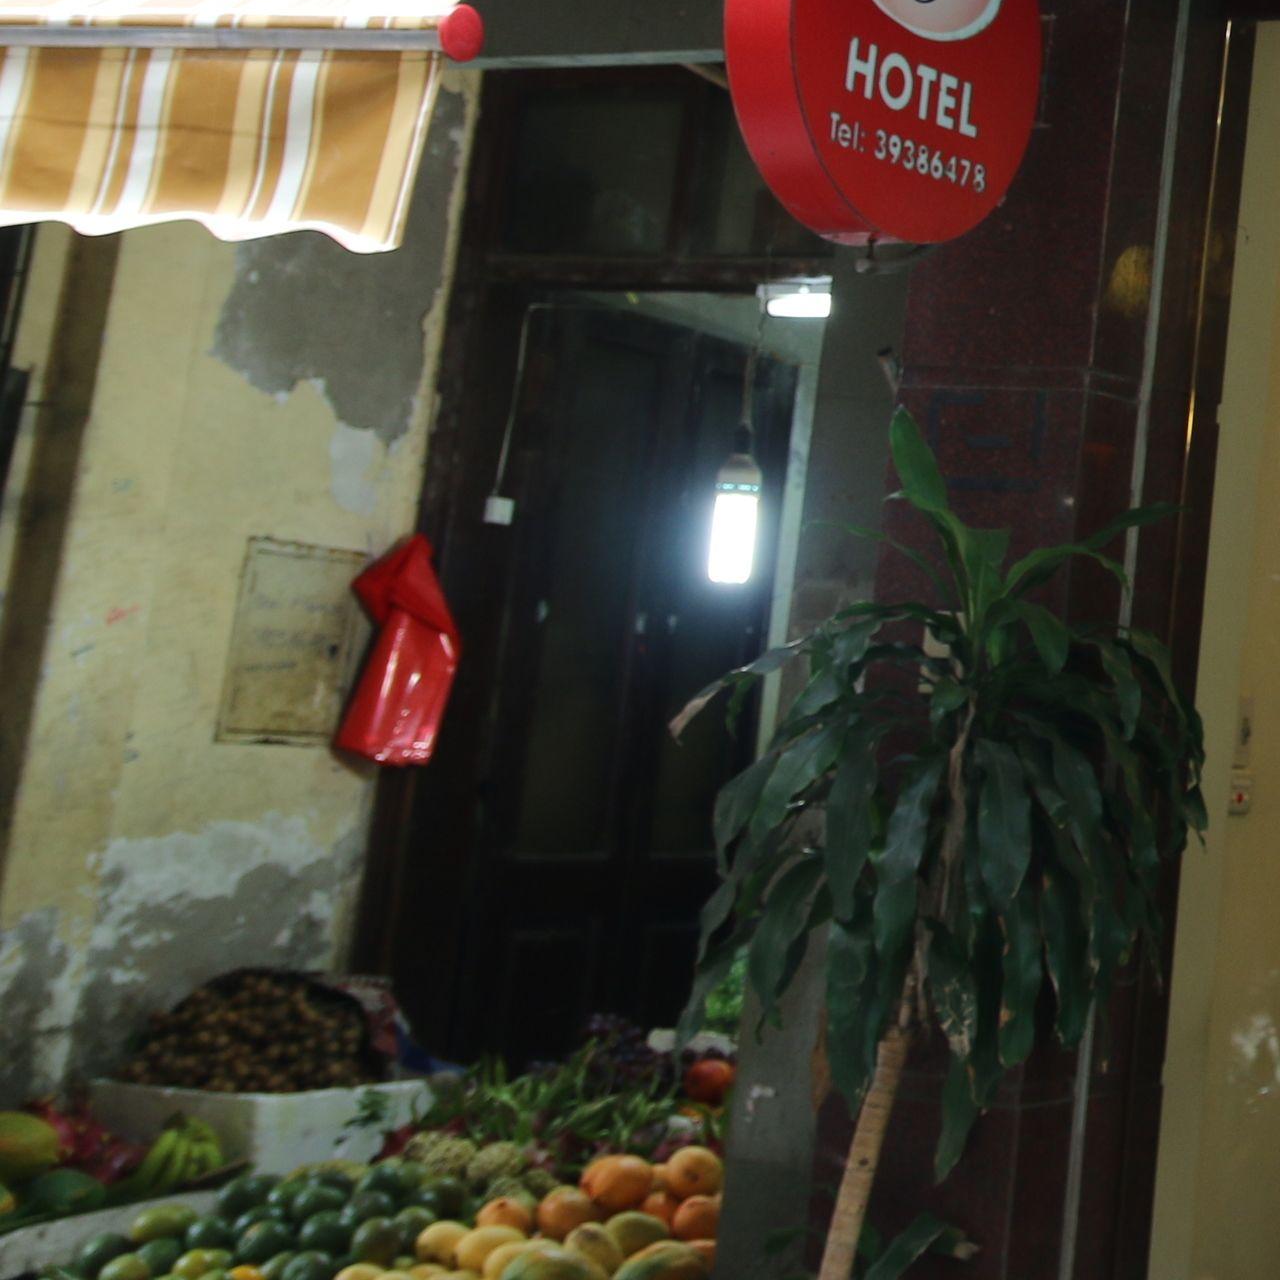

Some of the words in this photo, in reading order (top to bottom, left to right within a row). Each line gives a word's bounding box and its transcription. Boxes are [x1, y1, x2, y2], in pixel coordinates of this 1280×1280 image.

[845, 36, 977, 138] HOTEL
[831, 112, 865, 152] Tel:
[874, 128, 987, 192] 39386478
